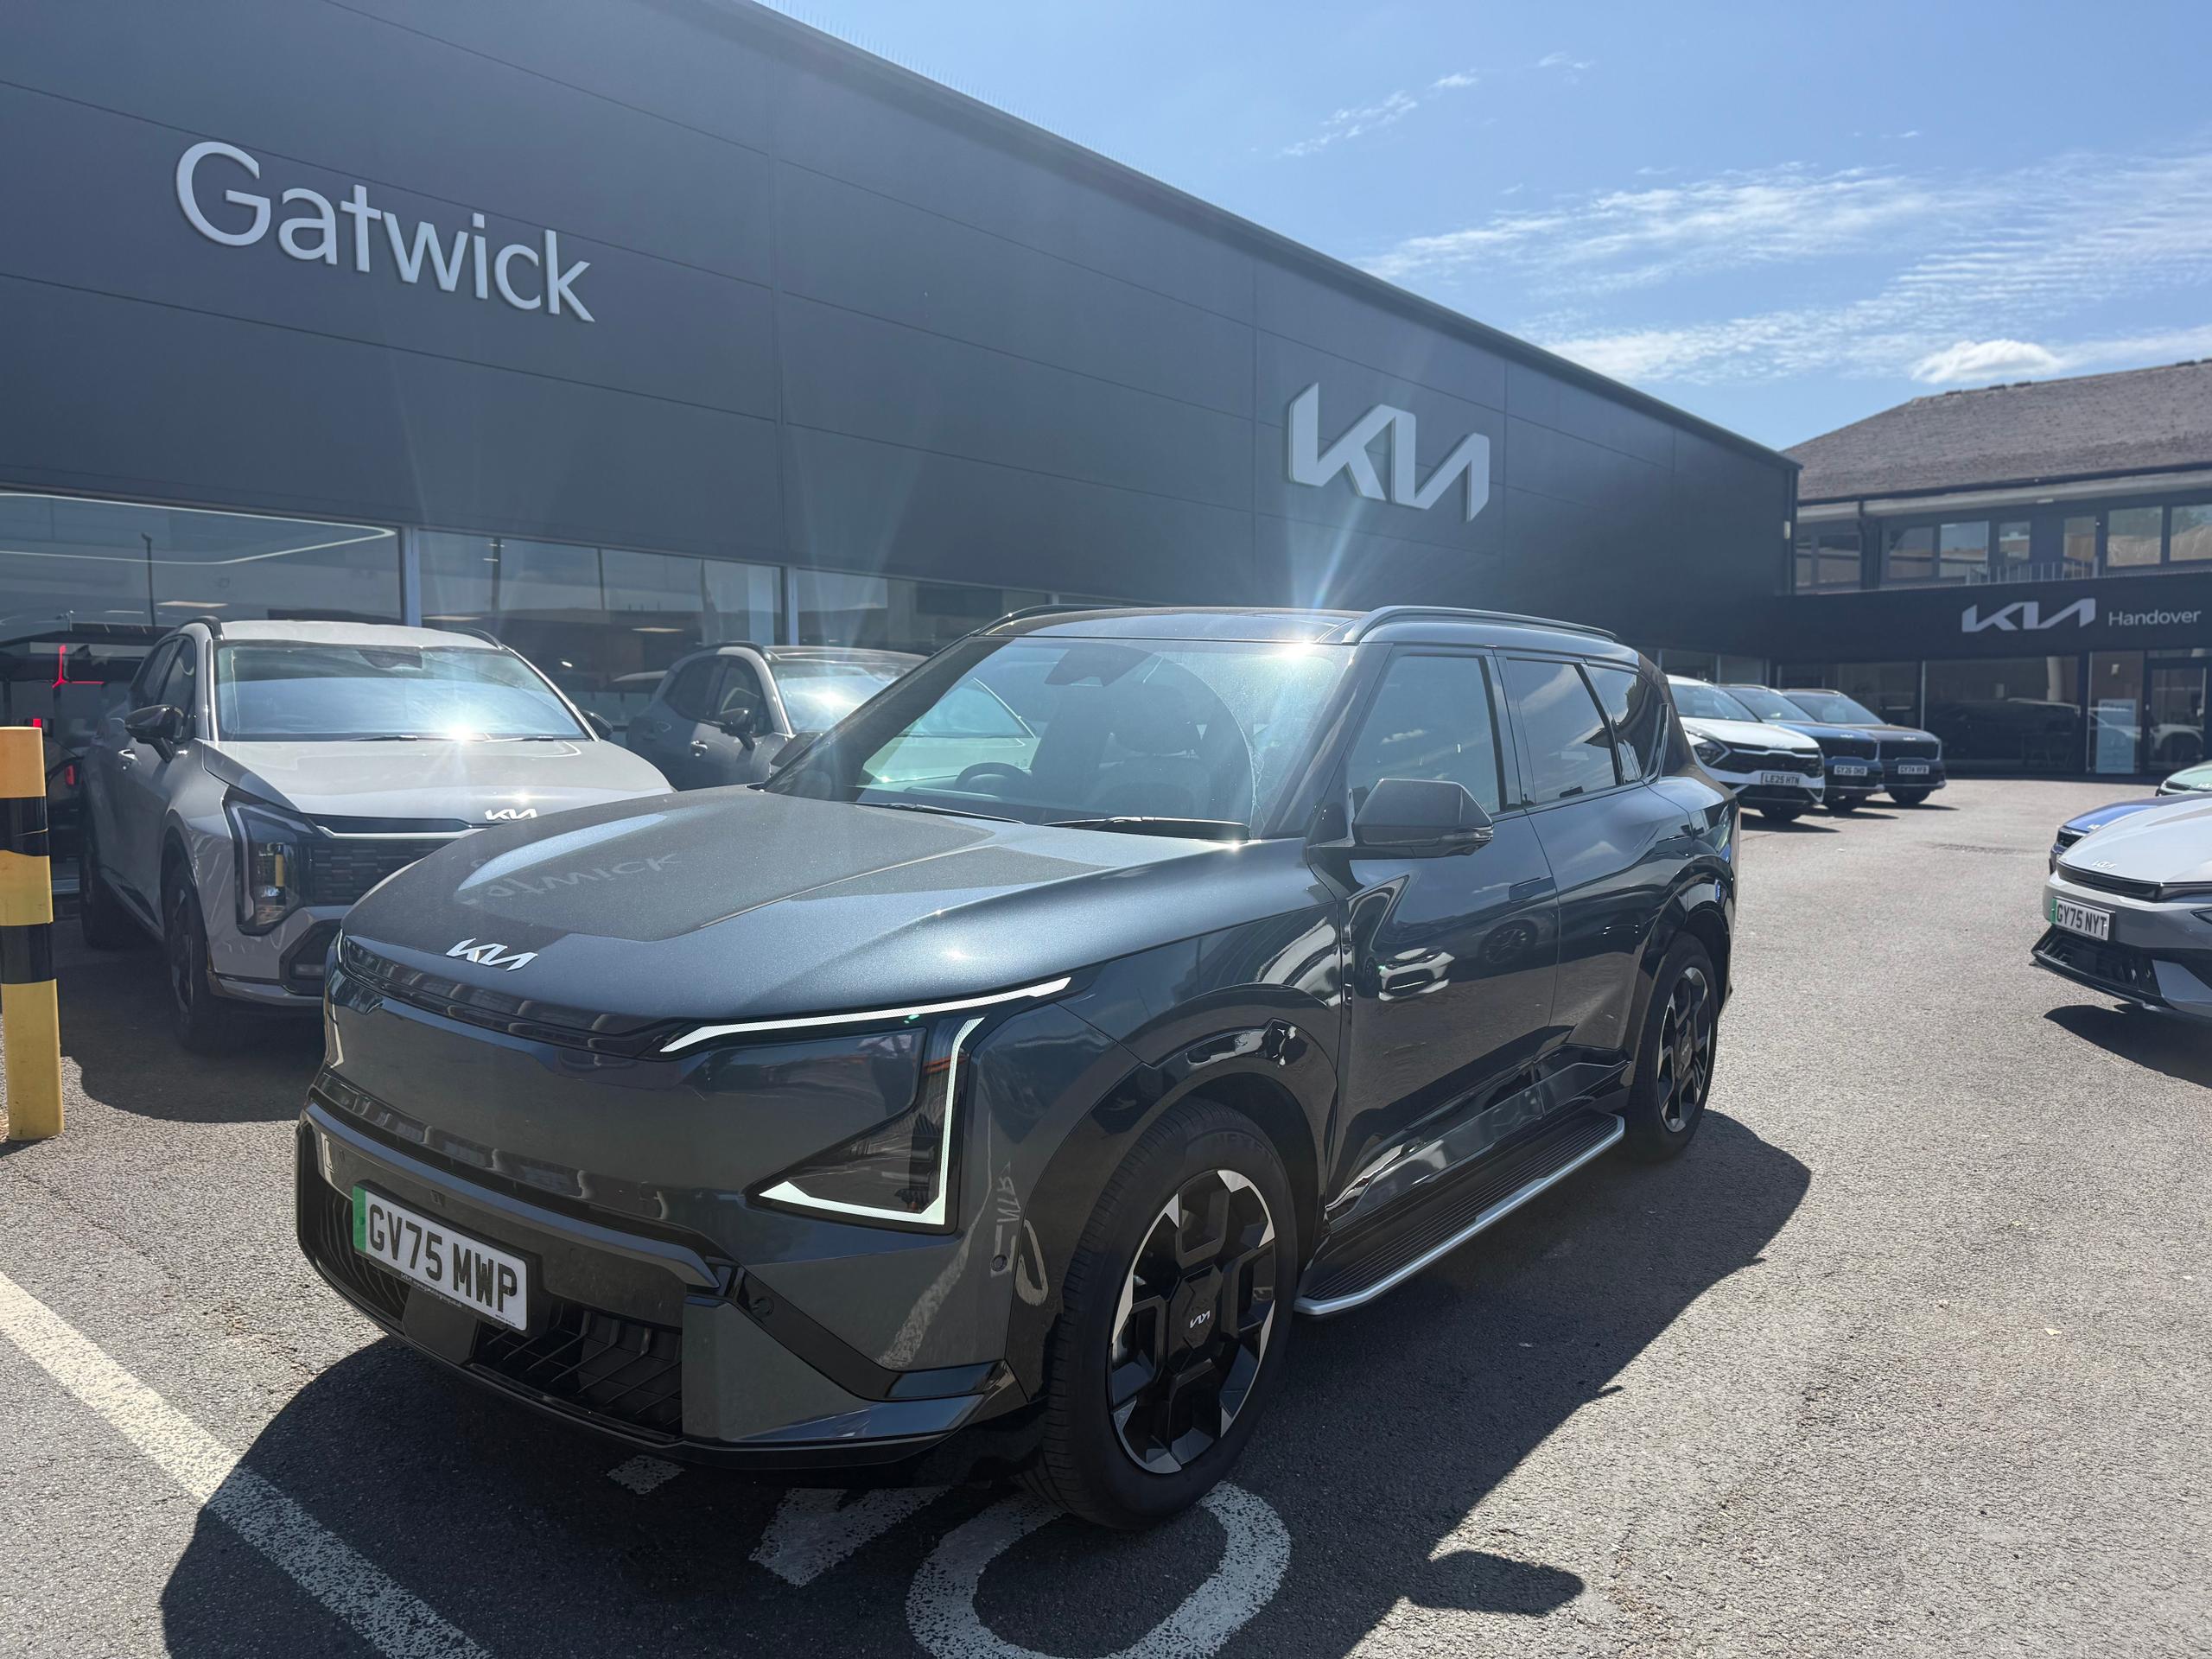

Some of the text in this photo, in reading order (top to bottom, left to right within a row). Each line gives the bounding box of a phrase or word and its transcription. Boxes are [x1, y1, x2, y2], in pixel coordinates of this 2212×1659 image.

[175, 141, 595, 322] Gatwick
[1288, 382, 1490, 522] KIA
[1961, 598, 2202, 632] KIA Handover
[485, 809, 537, 820] KIA
[2056, 904, 2107, 936] GY75 NYT
[446, 938, 538, 972] KIA
[369, 1203, 518, 1313] GV75 MWP
